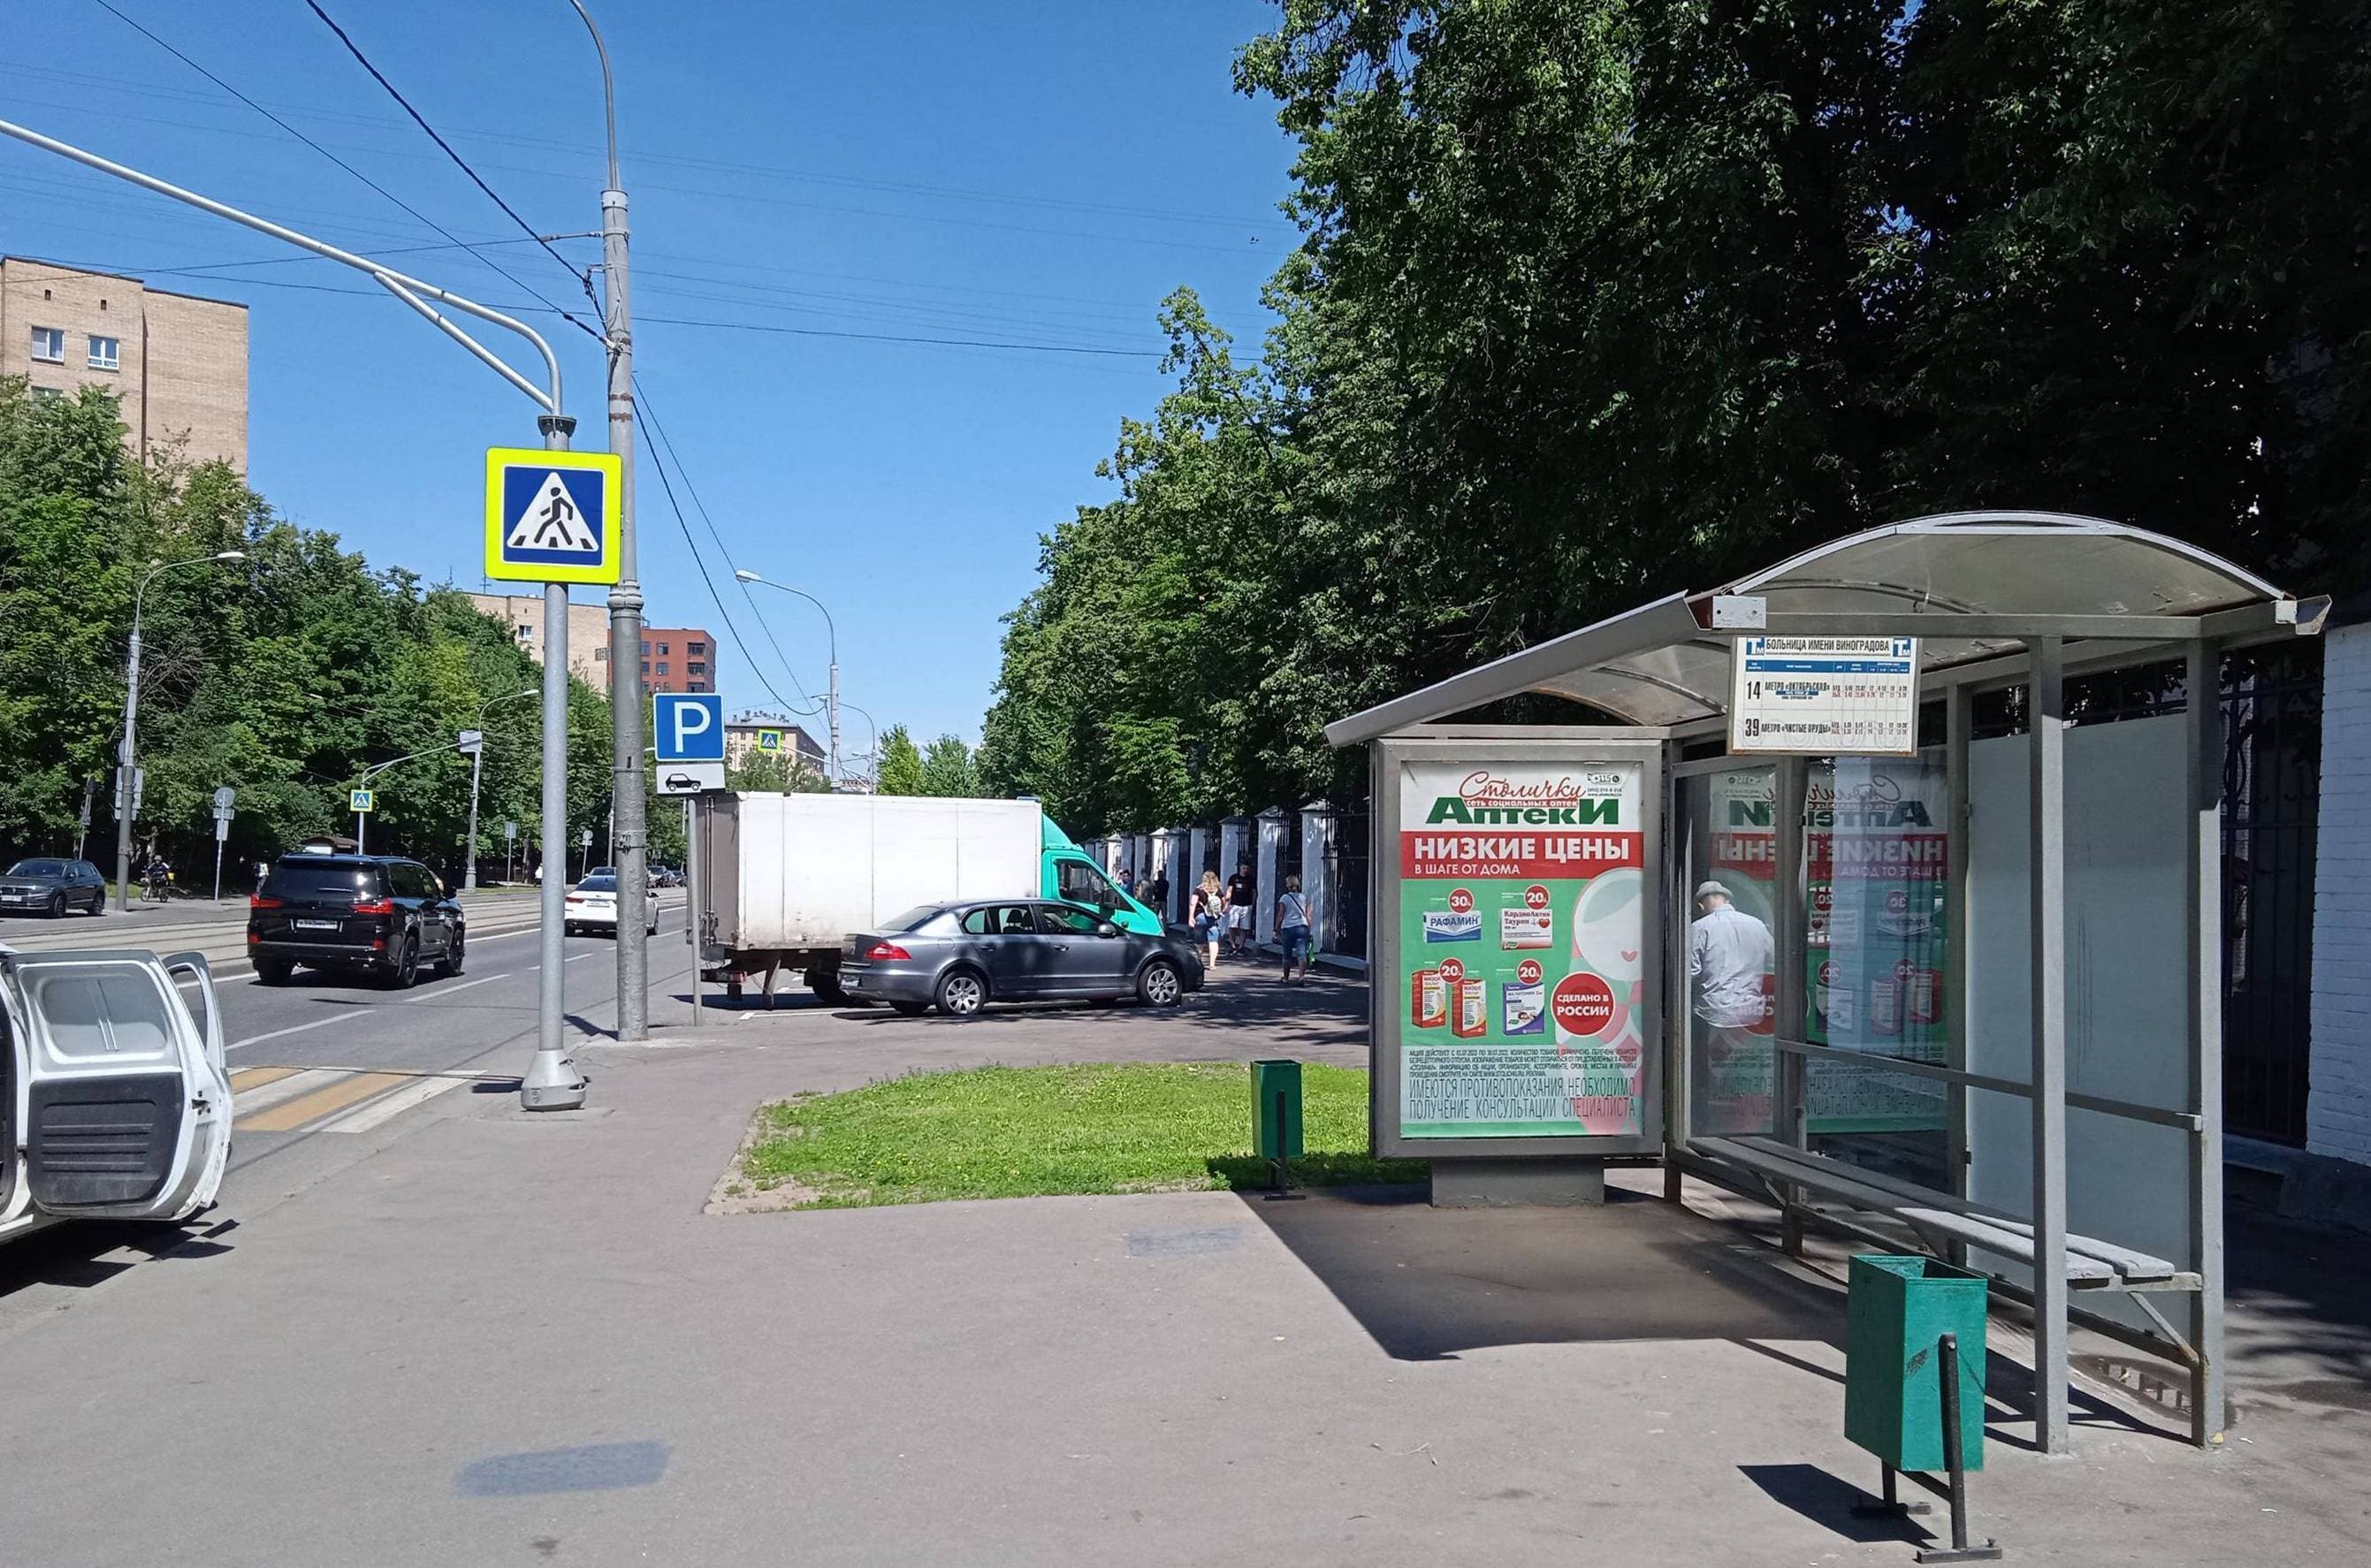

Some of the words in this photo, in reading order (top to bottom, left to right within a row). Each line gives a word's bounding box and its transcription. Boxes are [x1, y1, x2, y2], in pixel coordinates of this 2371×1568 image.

[1765, 638, 1807, 651] БОЛЬНИЦА
[1808, 639, 1834, 651] ИМЕНИ
[1836, 640, 1890, 652] ВИНОГРАДОВА
[1747, 681, 1761, 700] 14
[1765, 681, 1784, 691] МЕТРО
[674, 701, 712, 753] P
[1745, 718, 1759, 737] 39
[1761, 723, 1780, 733] МЕТРО
[1459, 771, 1587, 798] Столички
[1488, 799, 1548, 808] социальных
[1414, 837, 1536, 860] НИЗКИЕ
[1544, 837, 1629, 864] ЦЕНЫ
[1414, 864, 1422, 875] В
[1425, 864, 1459, 876] ШАГЕ
[1461, 864, 1476, 875] ОТ
[1480, 864, 1521, 876] ДОМА
[1557, 994, 1601, 1003] СДЕЛАНО
[1557, 1006, 1610, 1016] РОССИИ
[1409, 1078, 1458, 1099] ИМЕЮТСЯ
[1460, 1077, 1566, 1098] ПРОТИВОПОКАЗАНИЯ.
[1568, 1077, 1635, 1097] НЕОБХОДИМО
[1409, 1099, 1470, 1119] ПОЛУЧЕНИЕ
[1475, 1098, 1556, 1120] КОНСУЛЬТАЦИИ
[1562, 1097, 1635, 1119] СПЕЦИАЛИСТА
